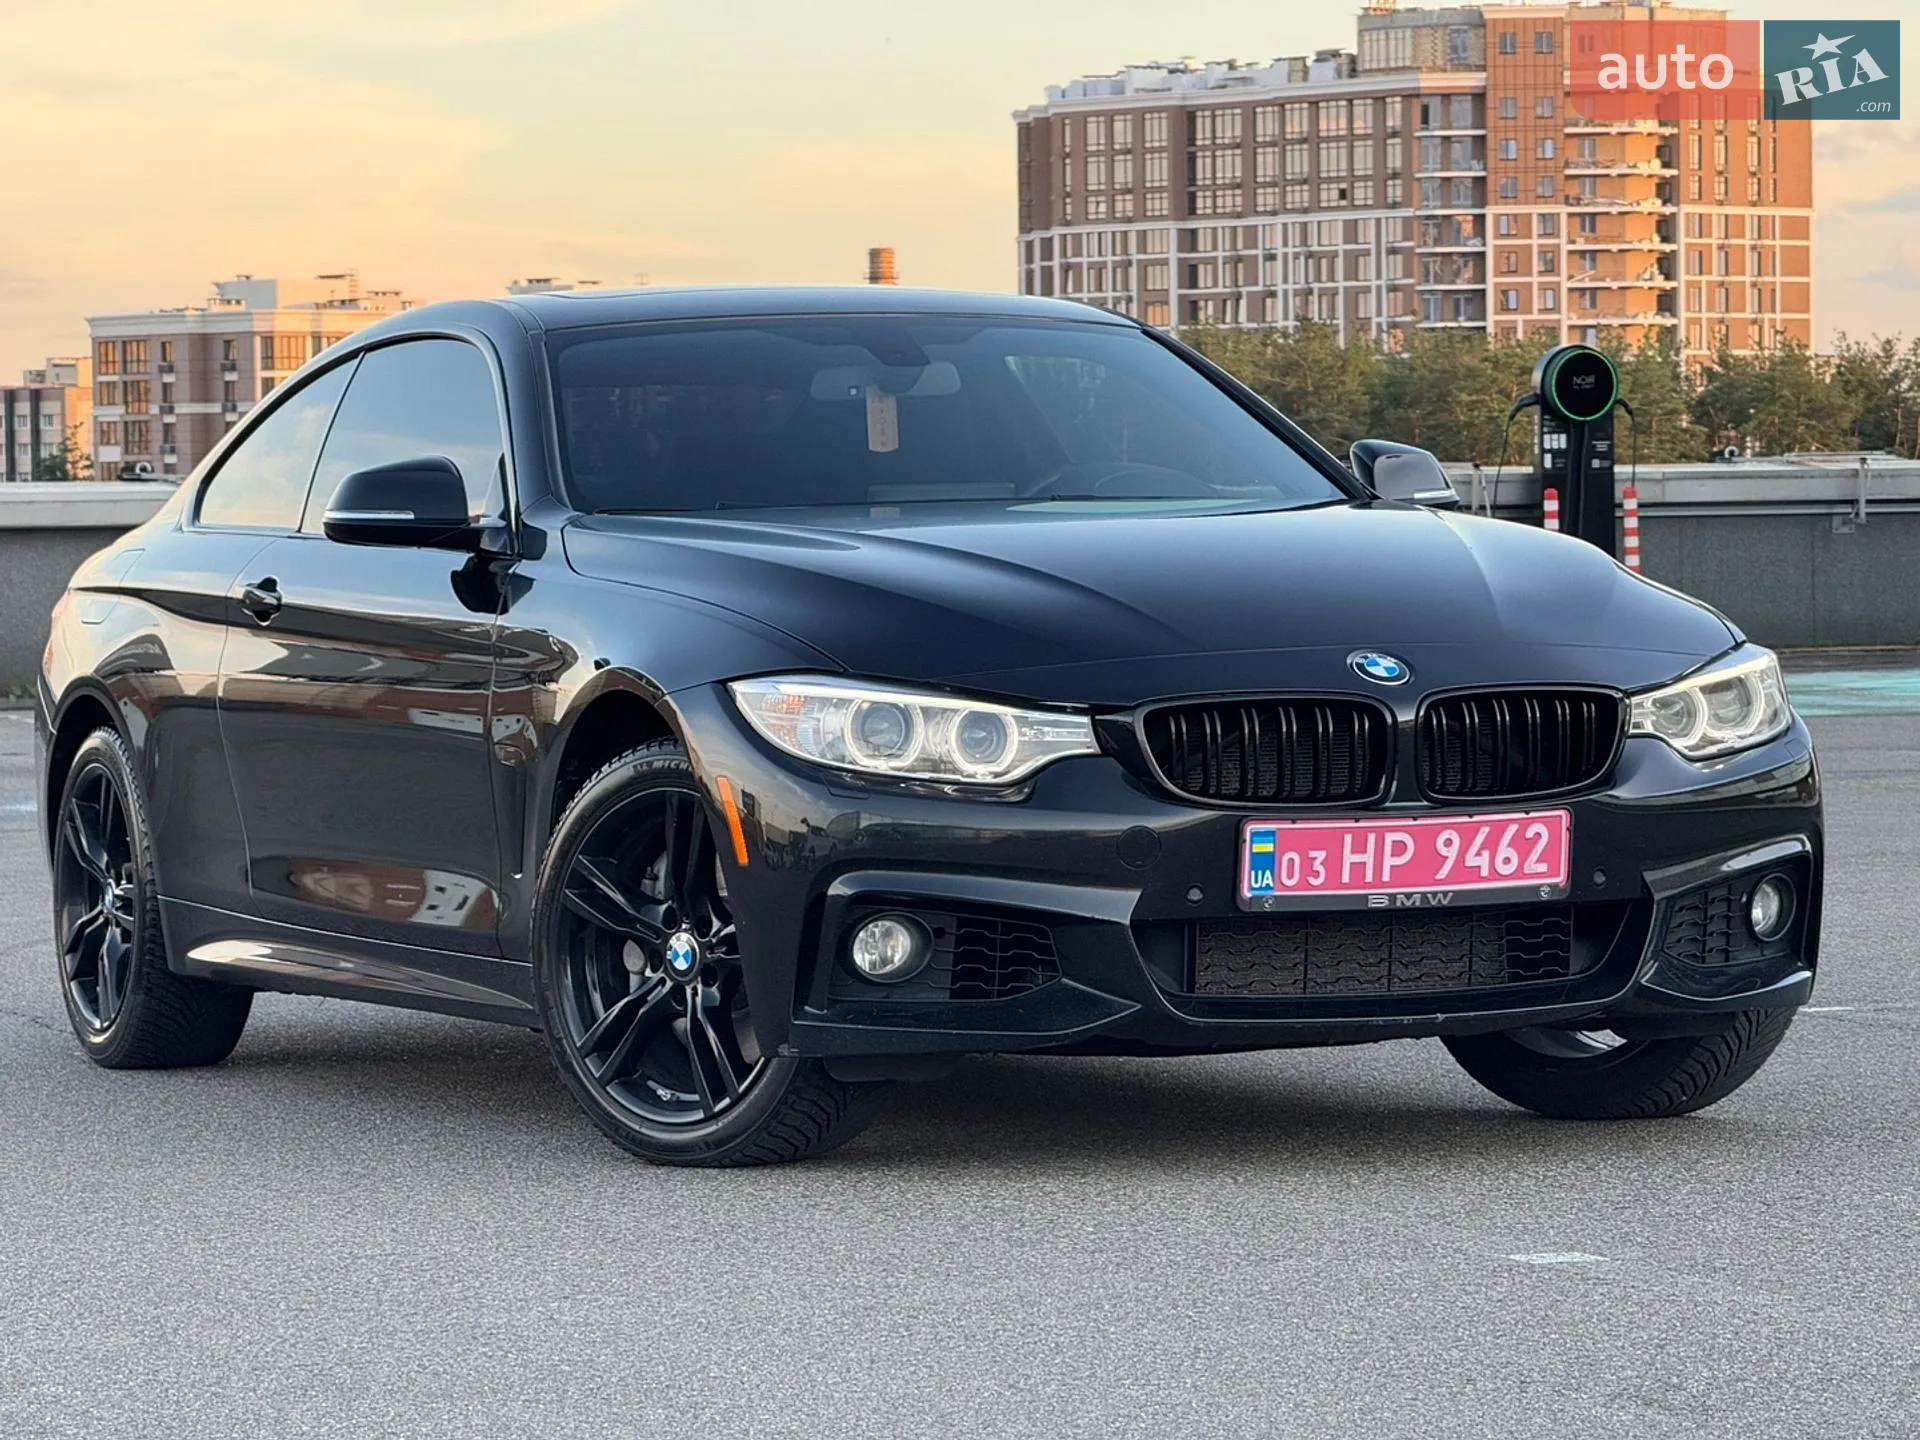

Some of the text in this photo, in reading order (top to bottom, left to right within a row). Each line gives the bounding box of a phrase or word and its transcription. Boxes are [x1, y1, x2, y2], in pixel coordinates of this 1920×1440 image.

[1279, 822, 1550, 887] 03 HP 9462
[1250, 870, 1274, 889] UA
[1367, 891, 1454, 908] BMW
